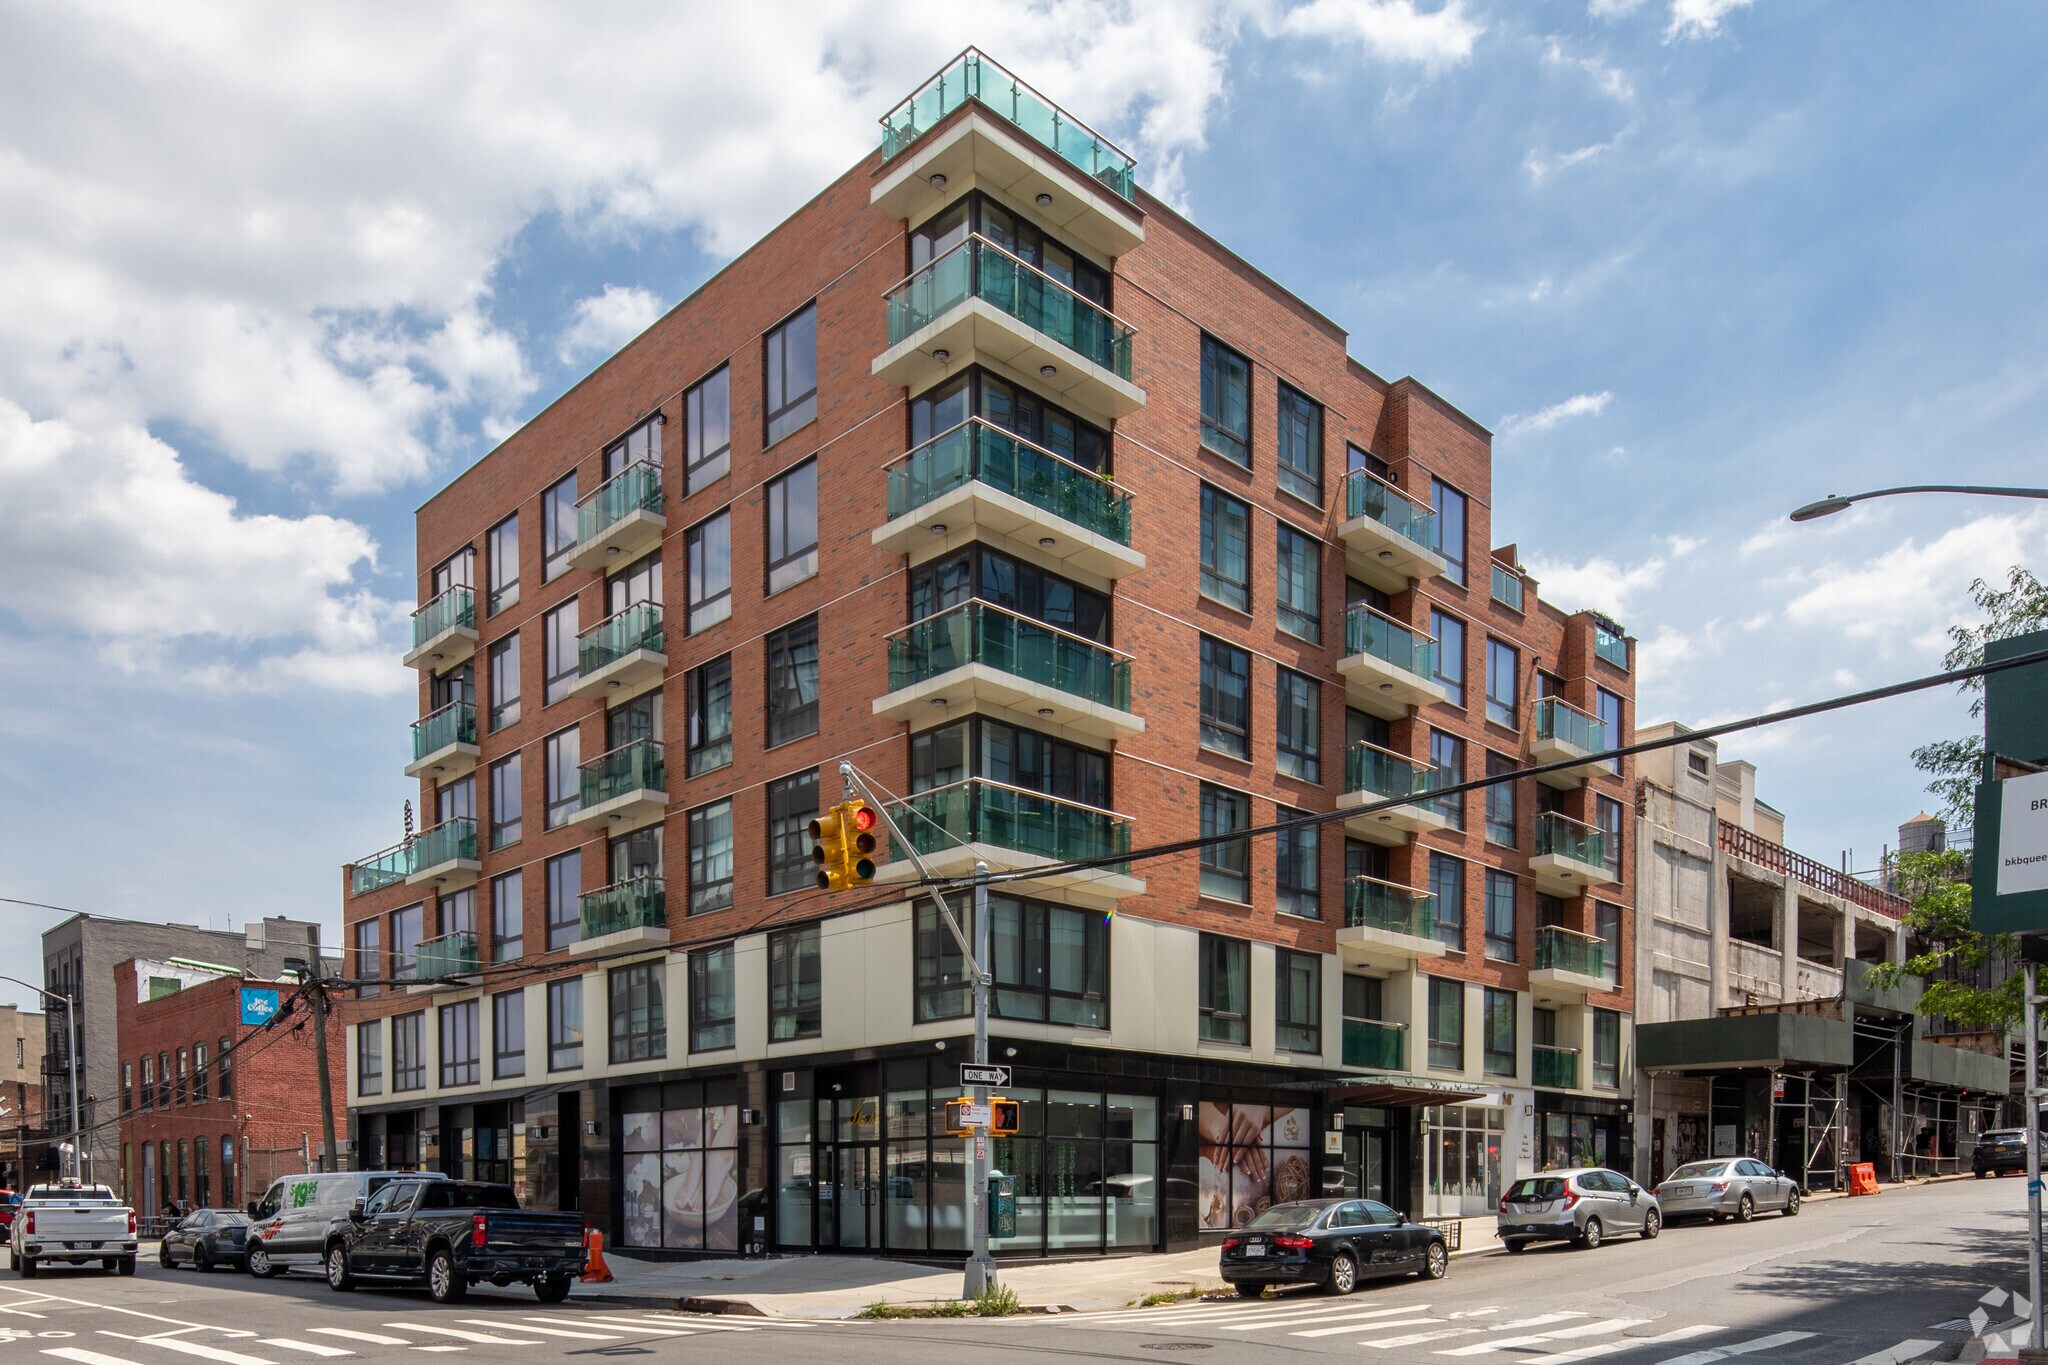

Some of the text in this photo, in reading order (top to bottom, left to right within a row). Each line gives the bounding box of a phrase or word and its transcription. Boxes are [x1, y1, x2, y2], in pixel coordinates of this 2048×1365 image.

[247, 1003, 273, 1012] Coffee
[968, 1071, 1004, 1081] ONE WAY
